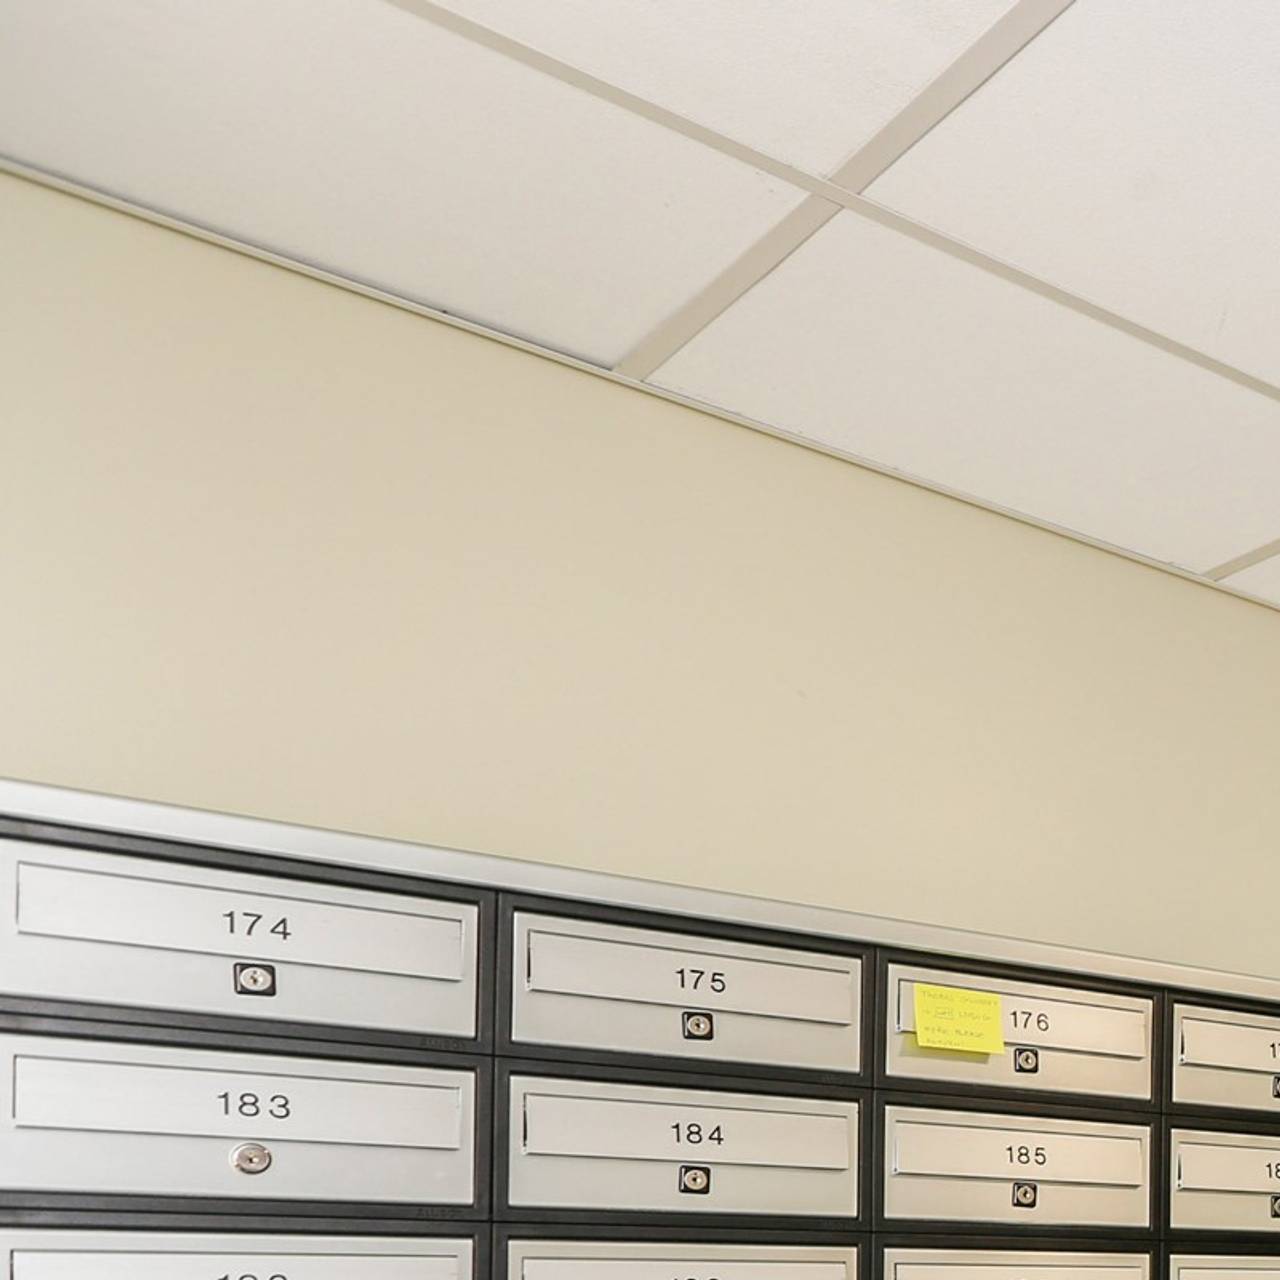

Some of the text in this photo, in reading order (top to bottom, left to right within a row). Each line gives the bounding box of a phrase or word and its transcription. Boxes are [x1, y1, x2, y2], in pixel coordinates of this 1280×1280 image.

[222, 910, 292, 941] 174
[675, 968, 726, 994] 175
[1009, 1010, 1050, 1032] 176
[217, 1091, 291, 1120] 183
[671, 1122, 725, 1146] 184
[1005, 1145, 1047, 1166] 185
